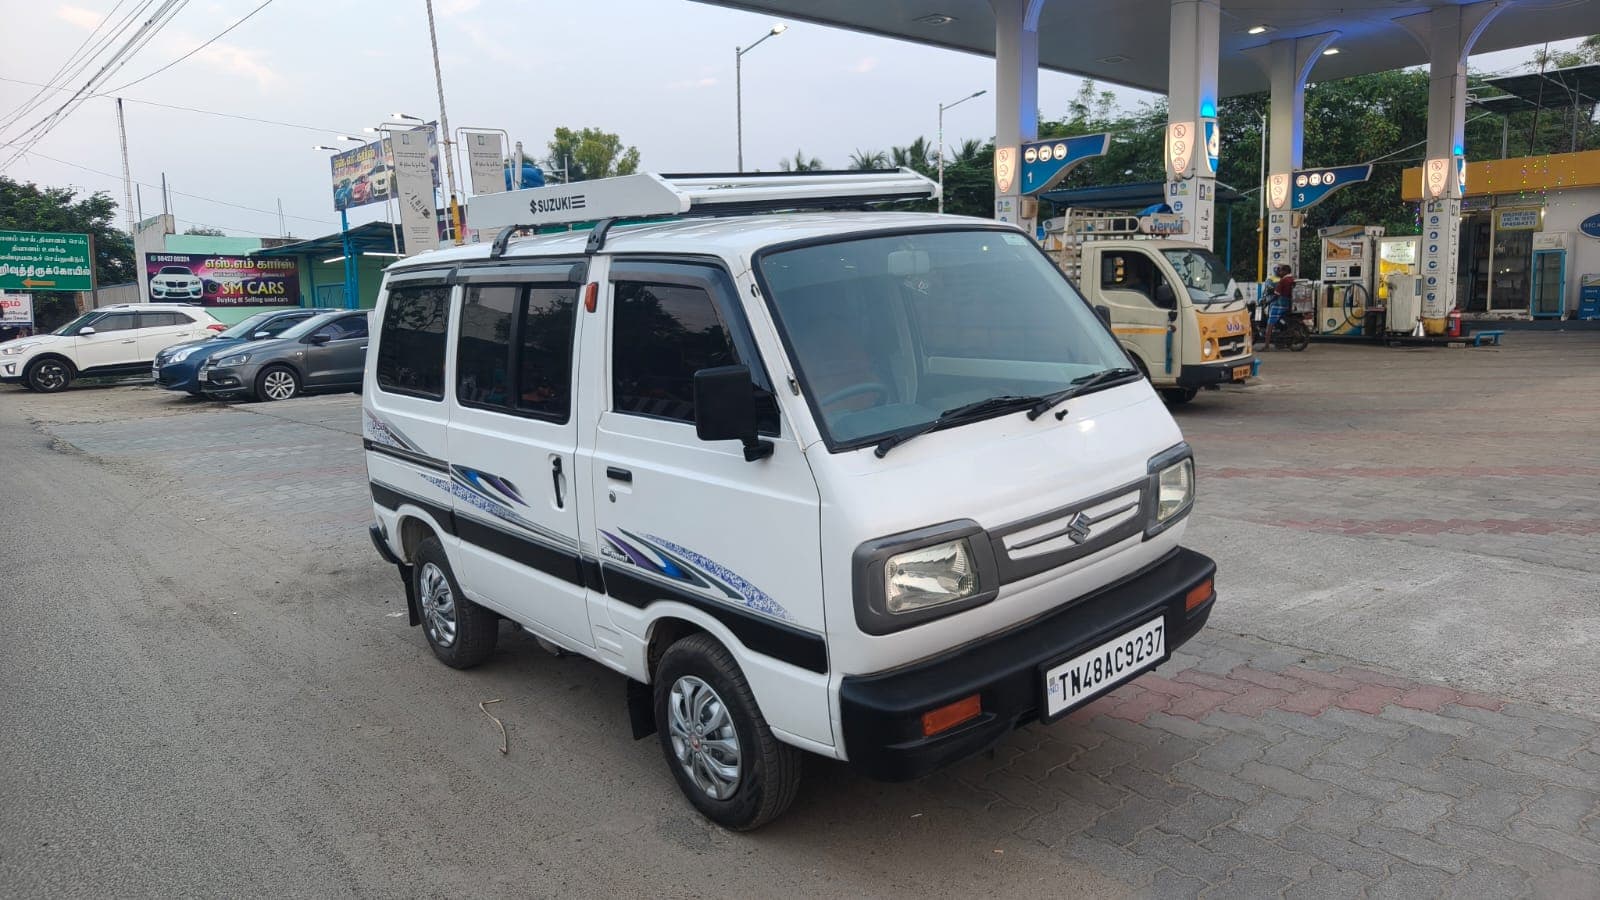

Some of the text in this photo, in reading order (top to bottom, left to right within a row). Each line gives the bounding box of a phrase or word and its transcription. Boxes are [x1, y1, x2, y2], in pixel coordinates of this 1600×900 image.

[1026, 171, 1033, 184] 1
[1298, 193, 1305, 202] 3
[537, 196, 571, 213] SUZUKI
[222, 281, 286, 295] SM CARS
[216, 296, 237, 304] Buying
[244, 296, 264, 304] Selling
[1059, 625, 1163, 701] TN48AC9237
